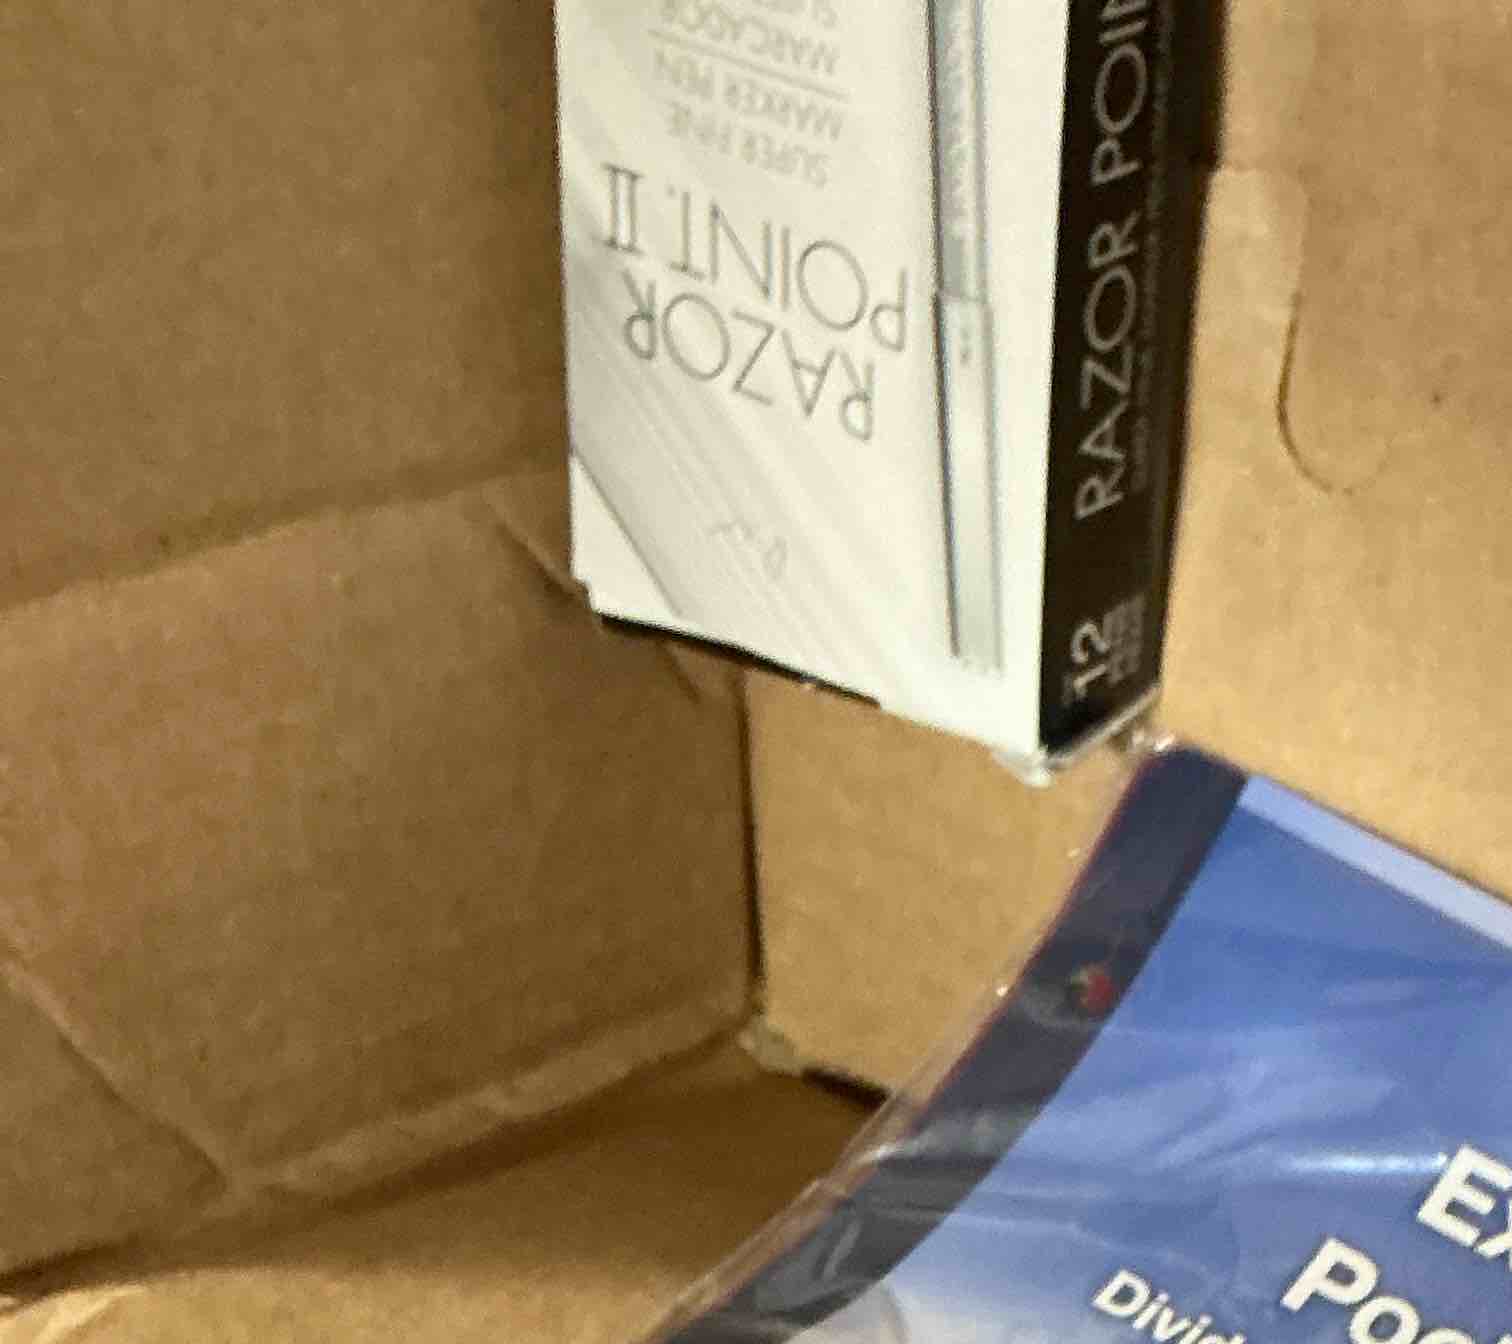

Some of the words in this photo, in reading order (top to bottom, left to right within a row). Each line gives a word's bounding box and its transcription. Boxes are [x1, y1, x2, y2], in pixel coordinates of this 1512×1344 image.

[600, 161, 646, 255] II
[622, 269, 875, 441] RAZOR
[1075, 206, 1144, 520] RAZOR
[1069, 614, 1111, 700] 12
